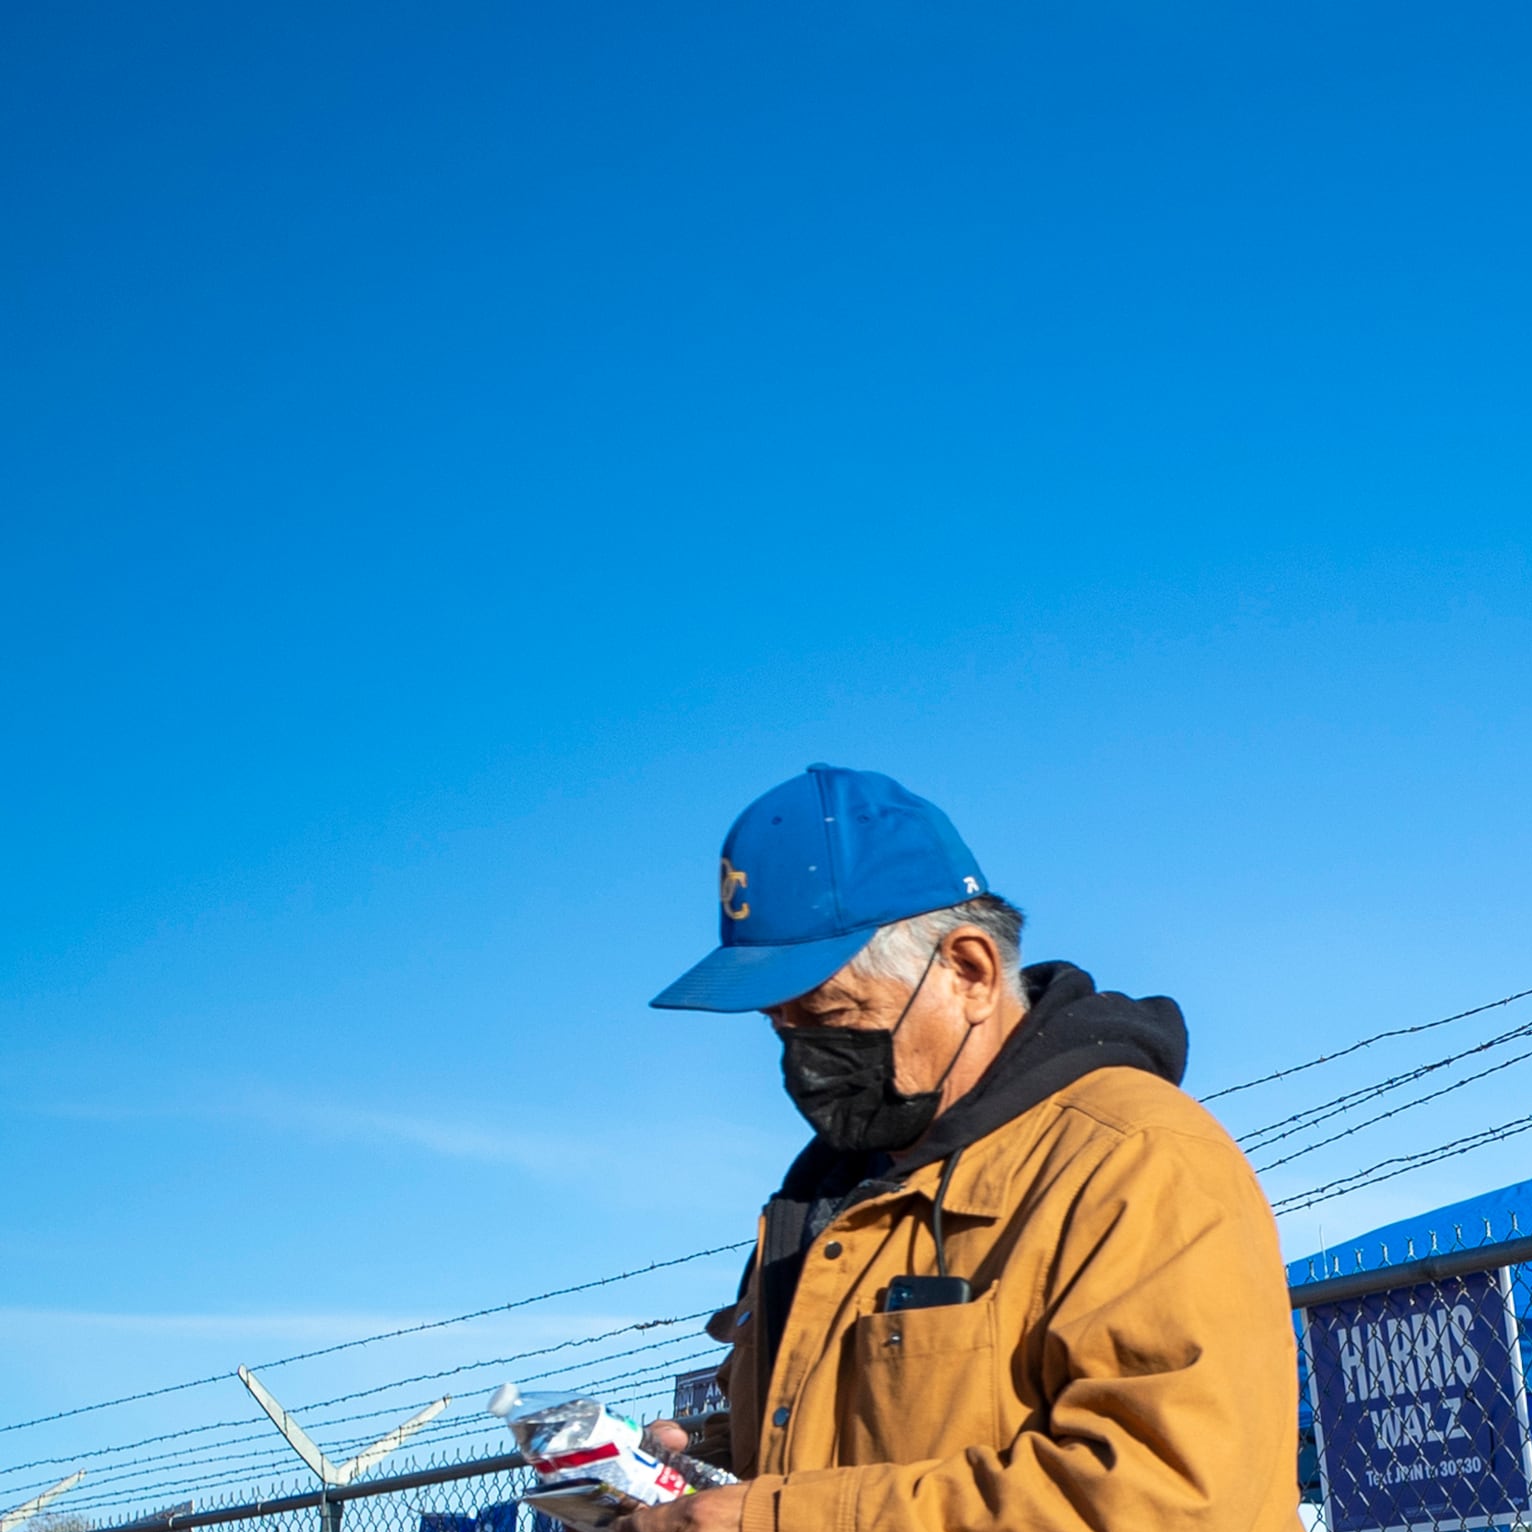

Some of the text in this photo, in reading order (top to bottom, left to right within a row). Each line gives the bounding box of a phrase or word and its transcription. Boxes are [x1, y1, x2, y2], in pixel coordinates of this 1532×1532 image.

[1337, 1305, 1480, 1403] HARRIS
[1370, 1398, 1465, 1449] WALZ
[1366, 1470, 1393, 1487] Text
